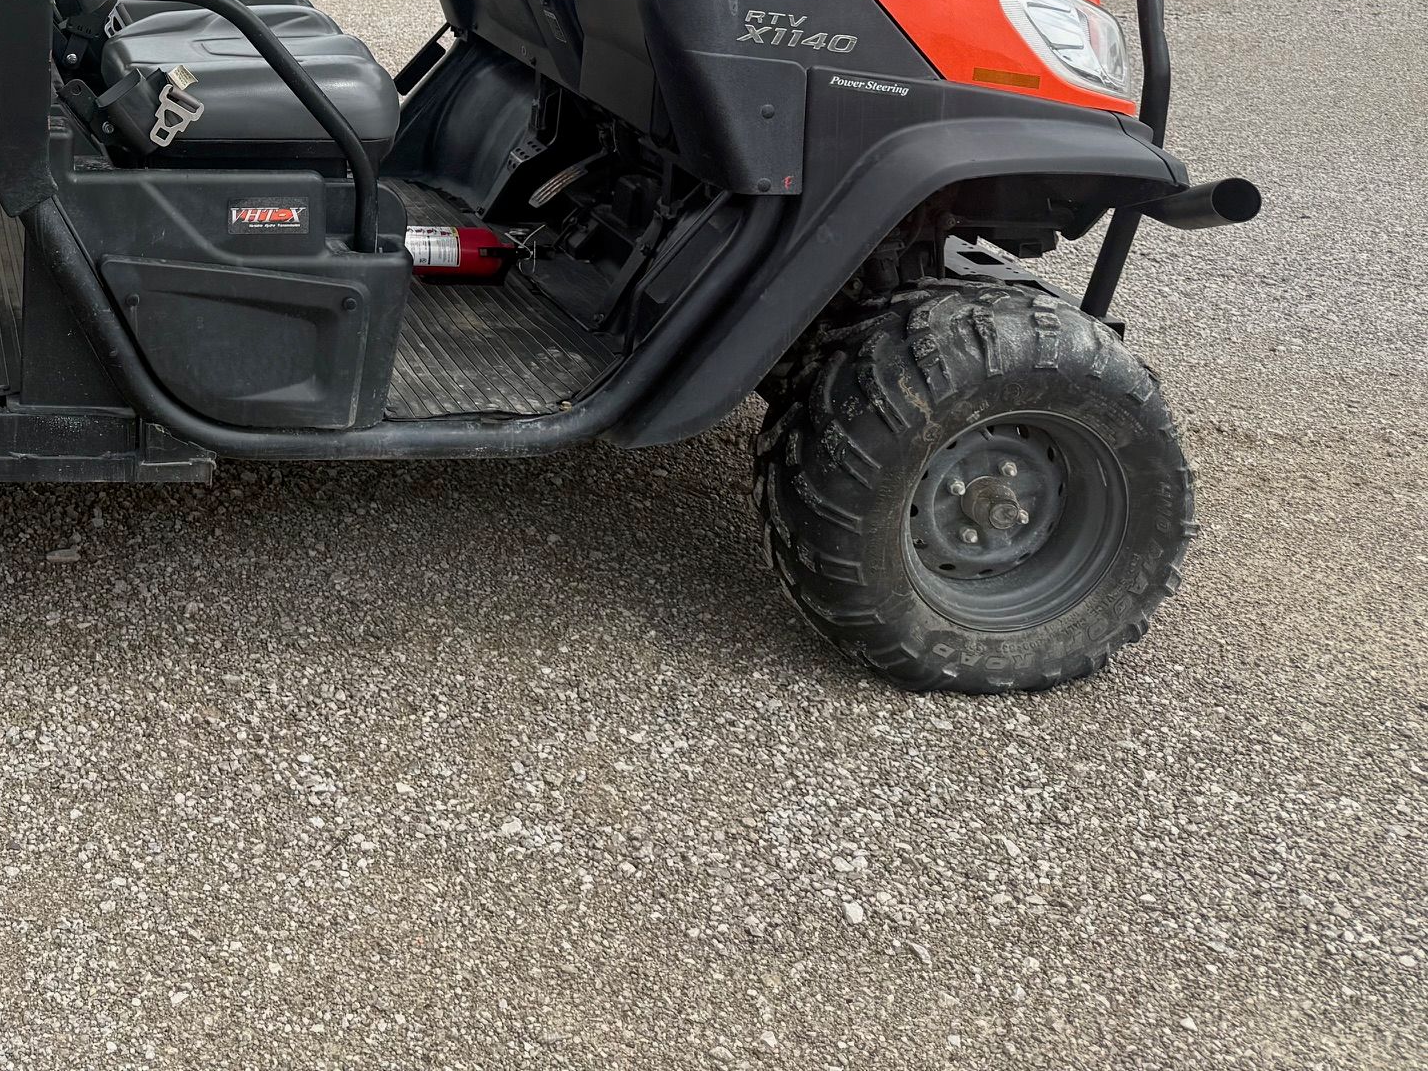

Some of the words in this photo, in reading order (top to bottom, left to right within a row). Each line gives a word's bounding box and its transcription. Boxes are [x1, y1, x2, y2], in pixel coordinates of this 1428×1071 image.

[744, 10, 808, 27] RTV
[736, 24, 858, 53] X1140
[829, 76, 865, 89] Power
[865, 81, 910, 96] Steering
[230, 207, 306, 224] VHT-X
